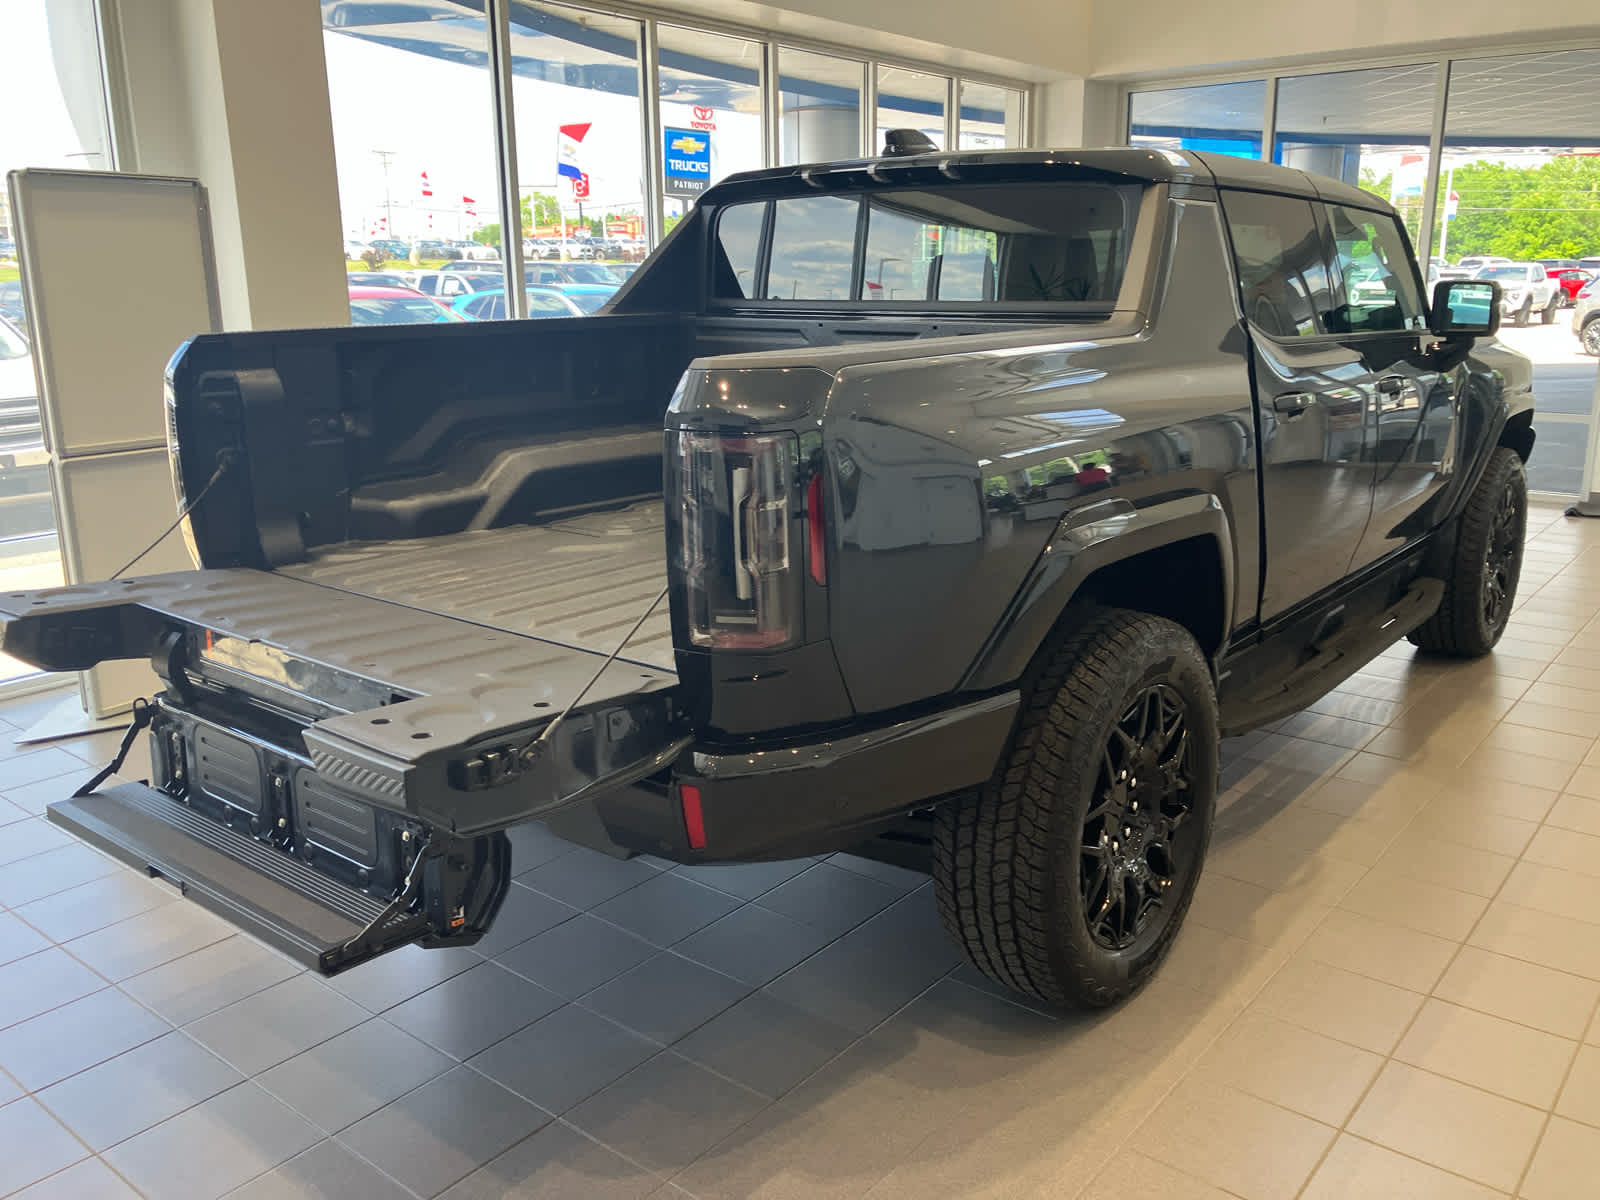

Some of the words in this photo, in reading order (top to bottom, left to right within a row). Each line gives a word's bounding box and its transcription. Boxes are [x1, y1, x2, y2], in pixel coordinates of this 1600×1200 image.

[690, 121, 717, 130] TOYOTA
[669, 159, 708, 172] TRUCKS
[674, 180, 704, 189] PATRIOT
